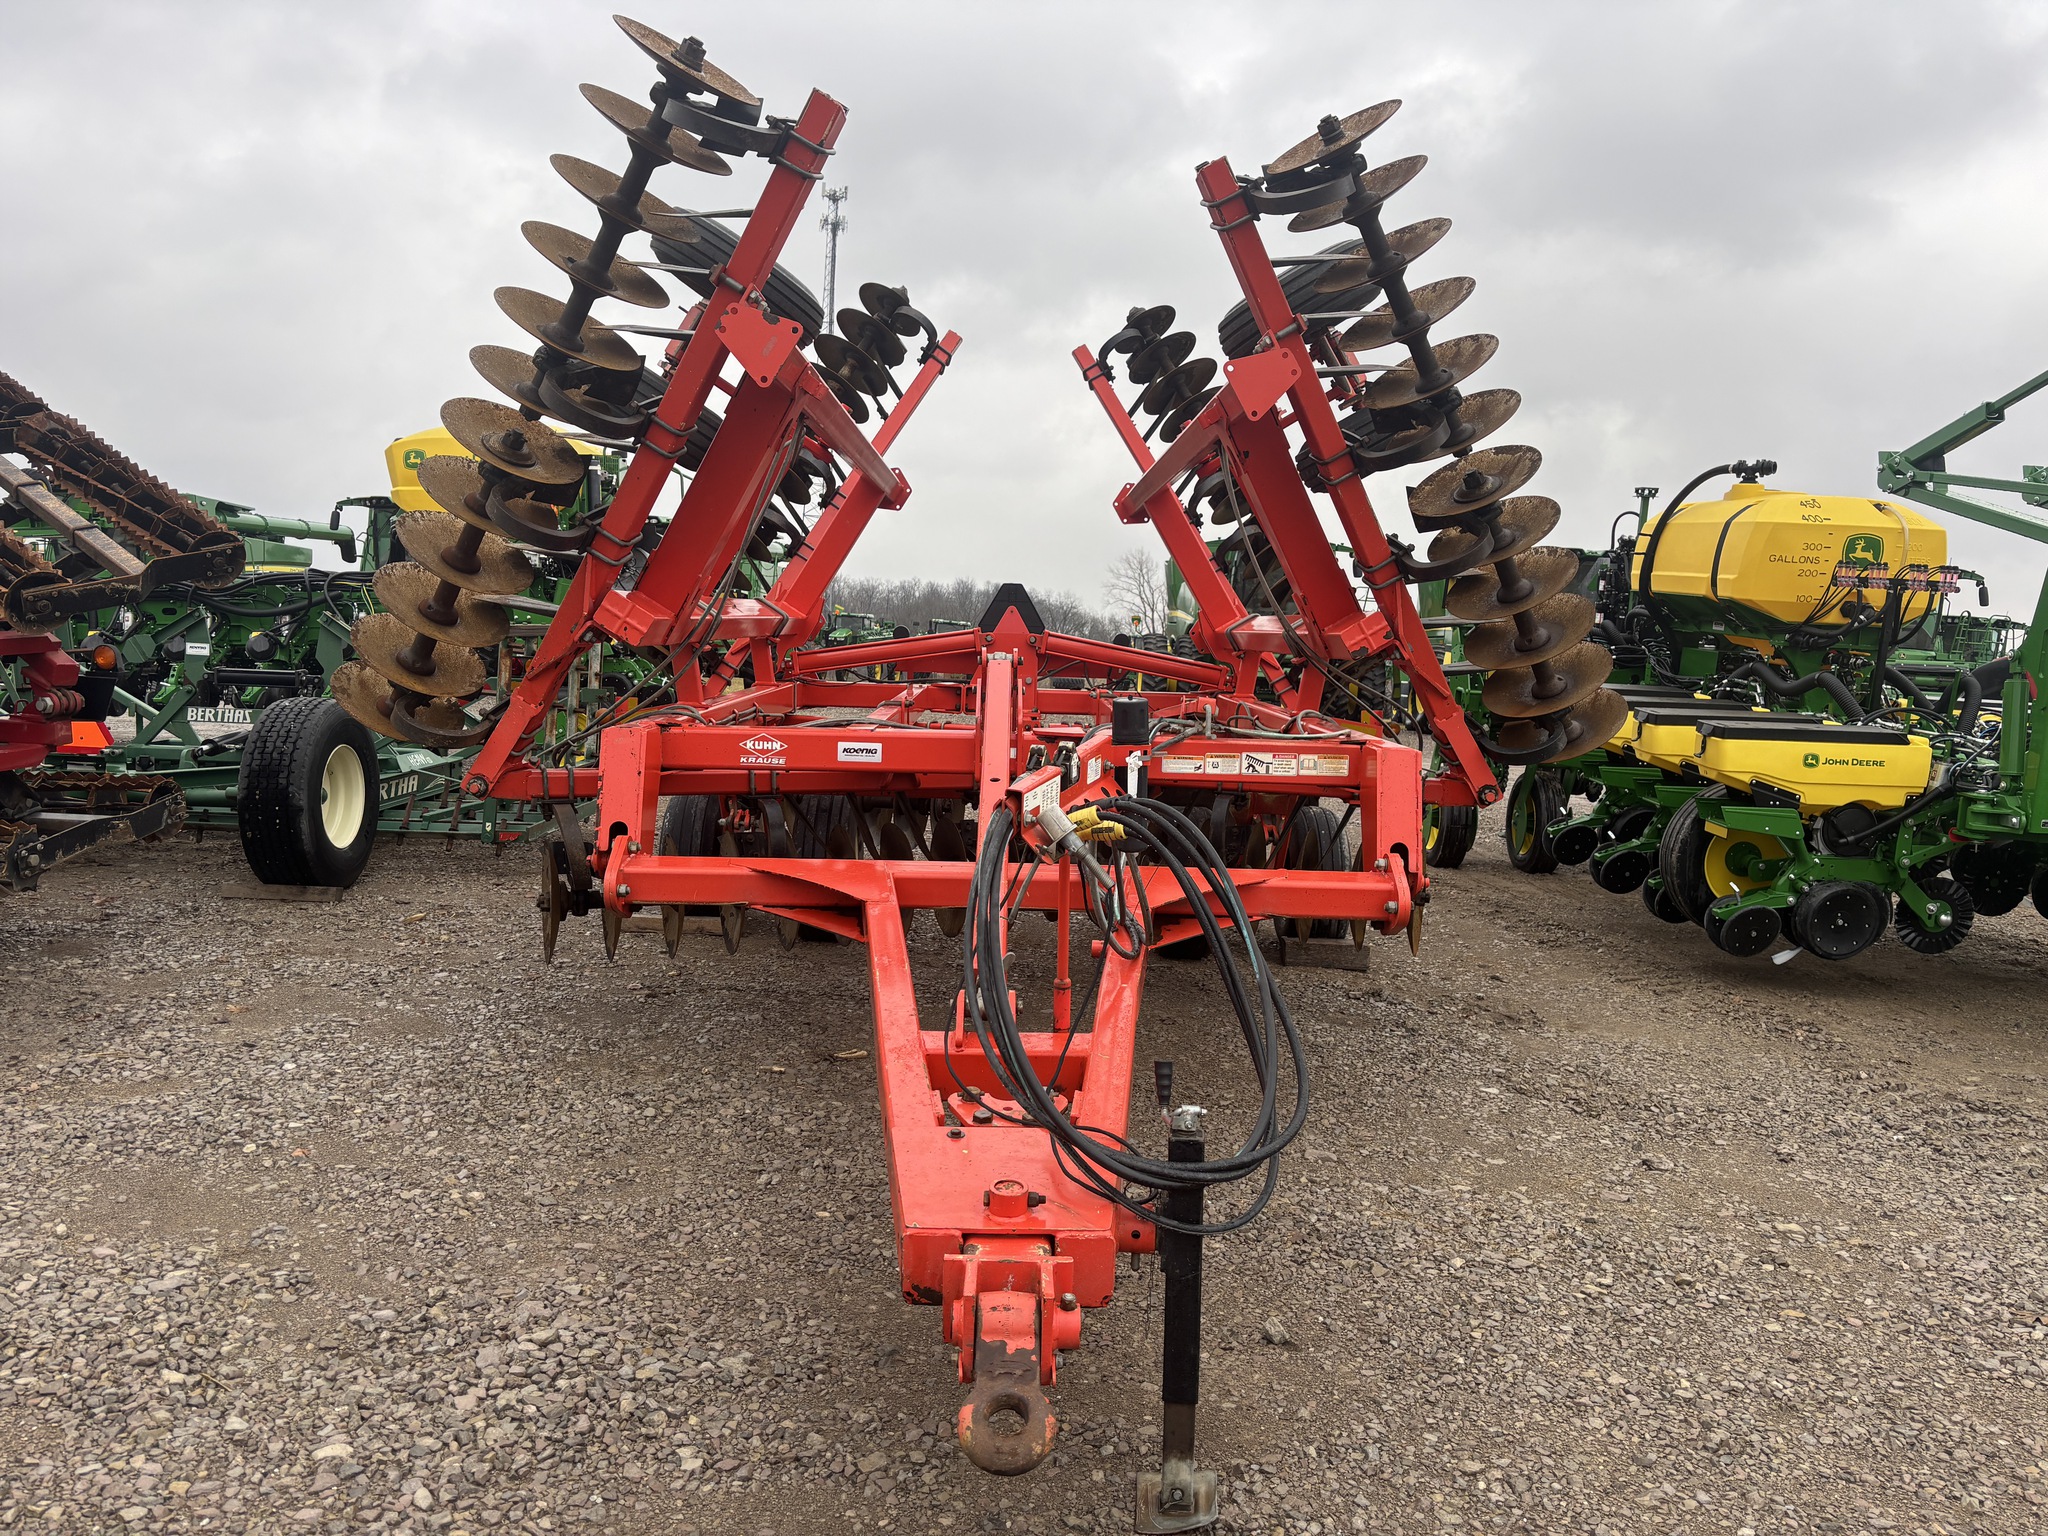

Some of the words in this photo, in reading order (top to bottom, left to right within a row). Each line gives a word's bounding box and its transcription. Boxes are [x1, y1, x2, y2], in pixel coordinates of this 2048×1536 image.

[1802, 514, 1824, 523] 400
[1802, 542, 1823, 551] 300
[1768, 554, 1821, 565] GALLONS
[1797, 568, 1819, 578] 200
[1796, 594, 1813, 603] 100
[186, 707, 253, 723] BERTHAS
[746, 740, 781, 750] KUHN
[740, 756, 786, 765] KRAUSE
[1821, 757, 1850, 767] JOHN
[1851, 758, 1886, 767] DEERE
[380, 774, 419, 802] RTHA
